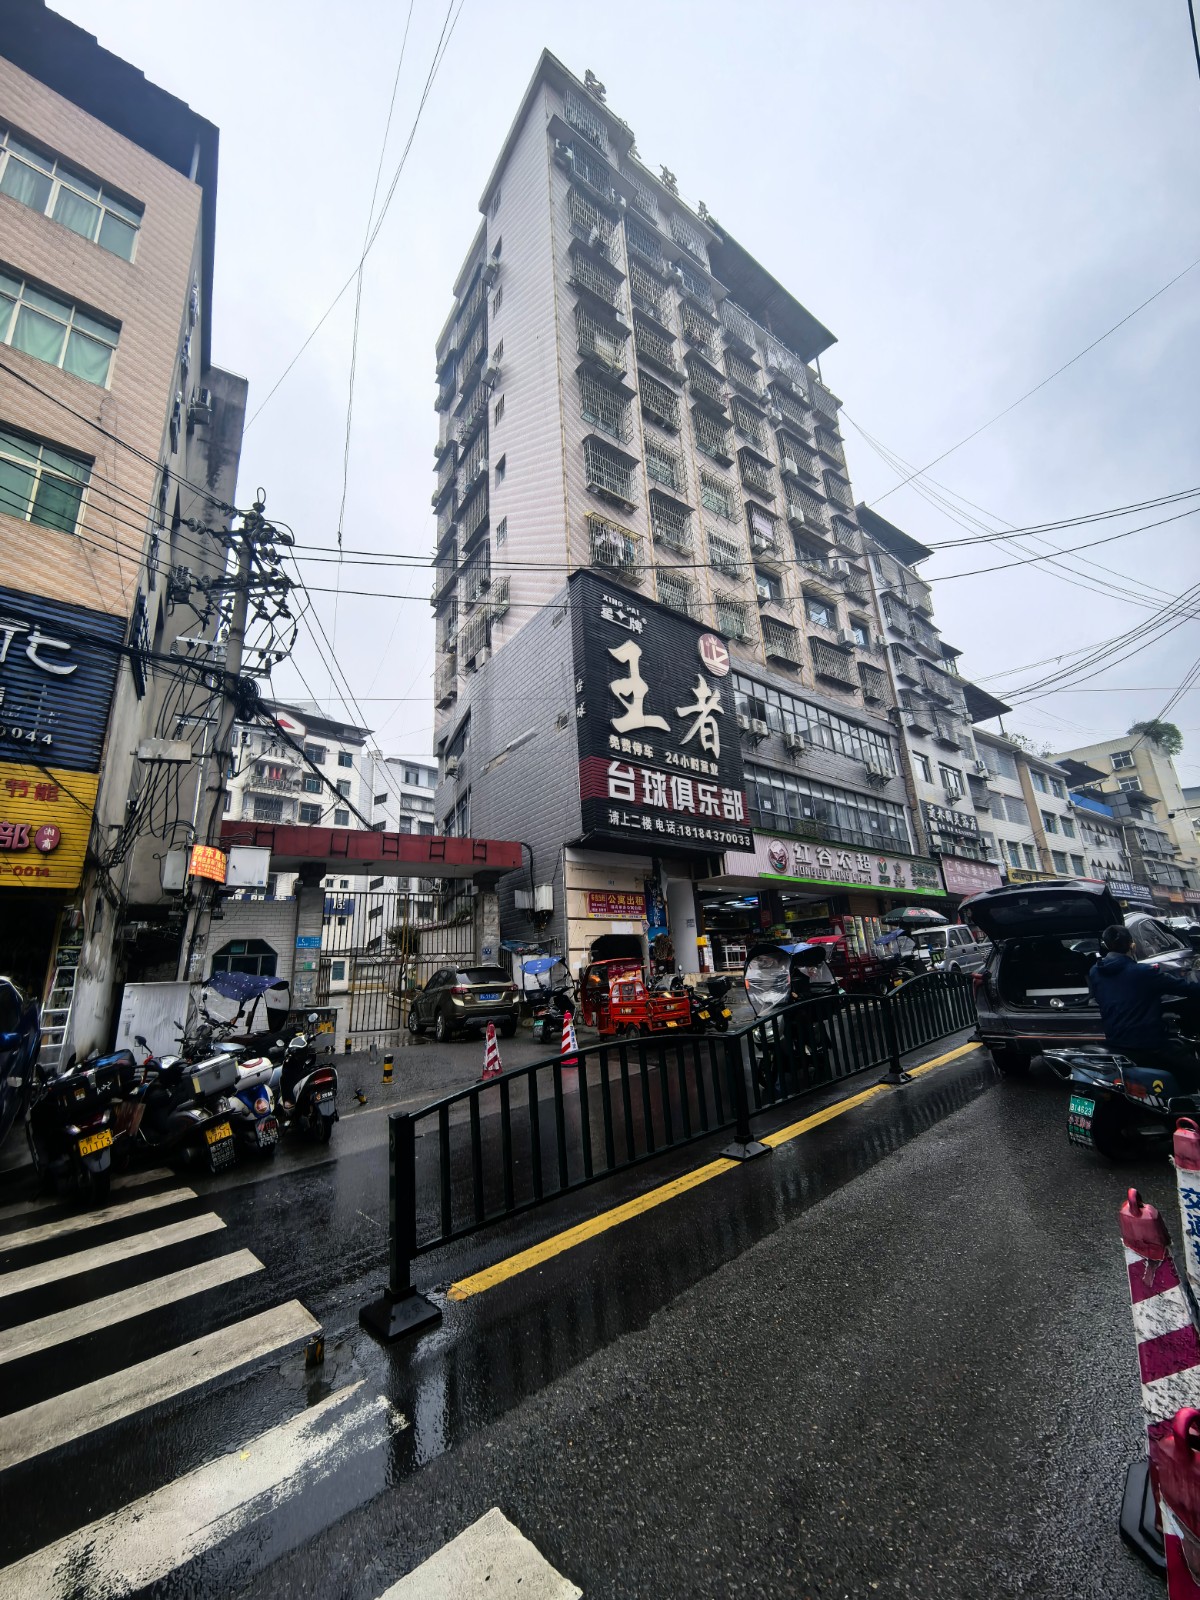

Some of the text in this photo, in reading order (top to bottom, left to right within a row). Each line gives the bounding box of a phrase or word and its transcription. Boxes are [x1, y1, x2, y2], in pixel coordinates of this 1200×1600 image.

[607, 639, 725, 759] 王者
[609, 734, 719, 776] 免费停车 24小时营业
[607, 760, 745, 822] 台球俱乐部
[608, 809, 653, 831] 请上二楼
[608, 894, 644, 906] 公寓出租
